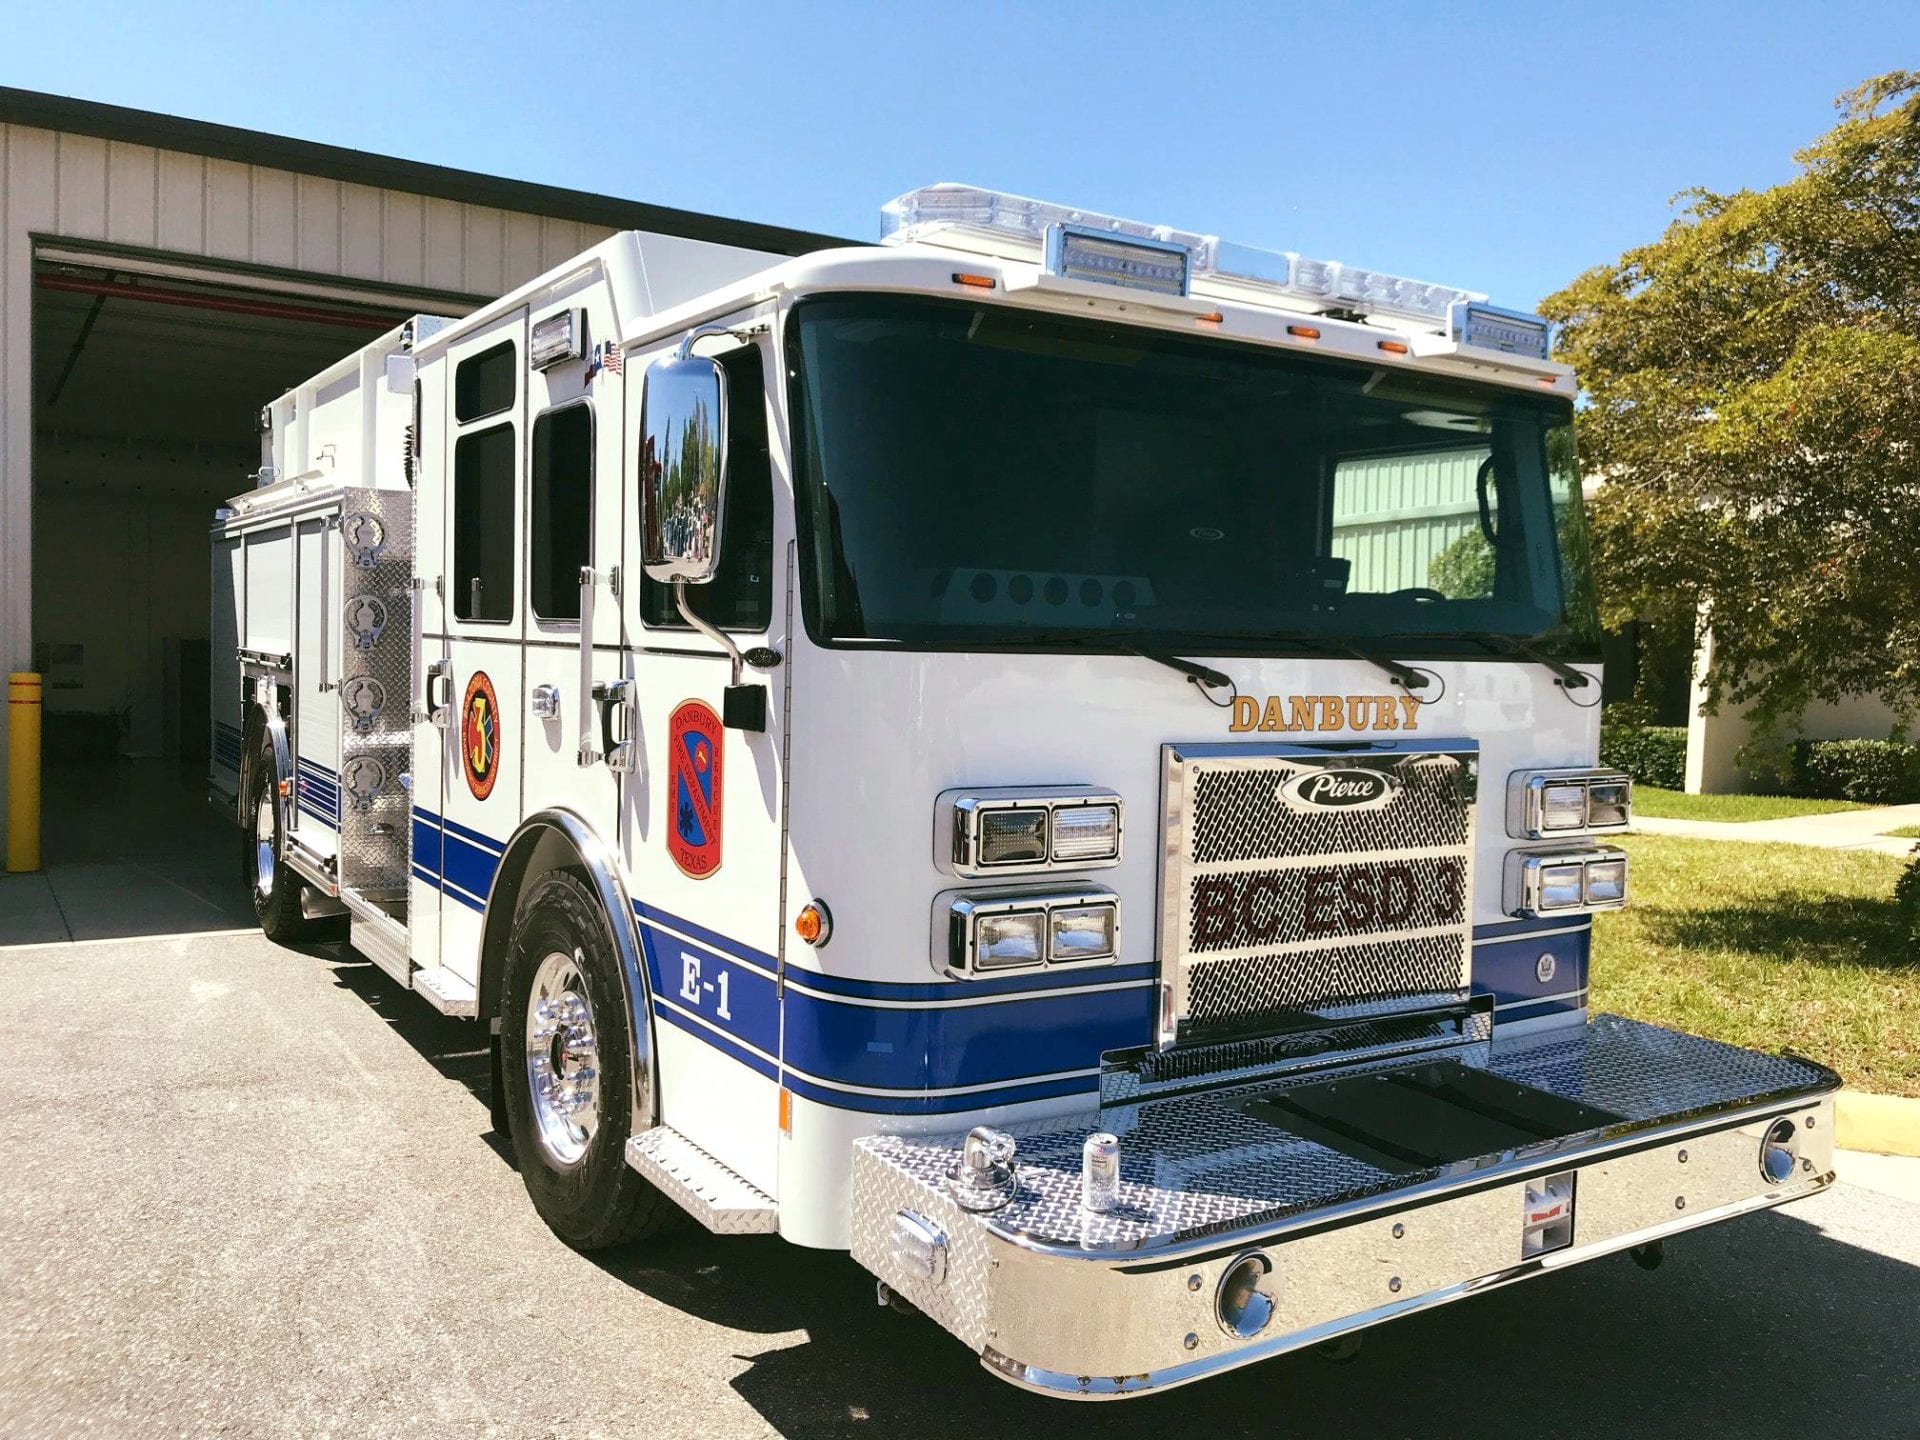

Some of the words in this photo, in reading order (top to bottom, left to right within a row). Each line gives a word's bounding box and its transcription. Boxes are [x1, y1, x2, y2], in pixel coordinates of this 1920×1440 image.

[471, 697, 488, 773] 3
[675, 710, 718, 735] DANBURY
[1229, 695, 1423, 732] DANBURY
[712, 746, 720, 830] RESCUE
[1310, 773, 1374, 802] Pierce
[679, 848, 707, 870] TEXAS
[1193, 877, 1281, 946] BC
[1300, 864, 1418, 934] ESD
[680, 951, 731, 1021] E-1
